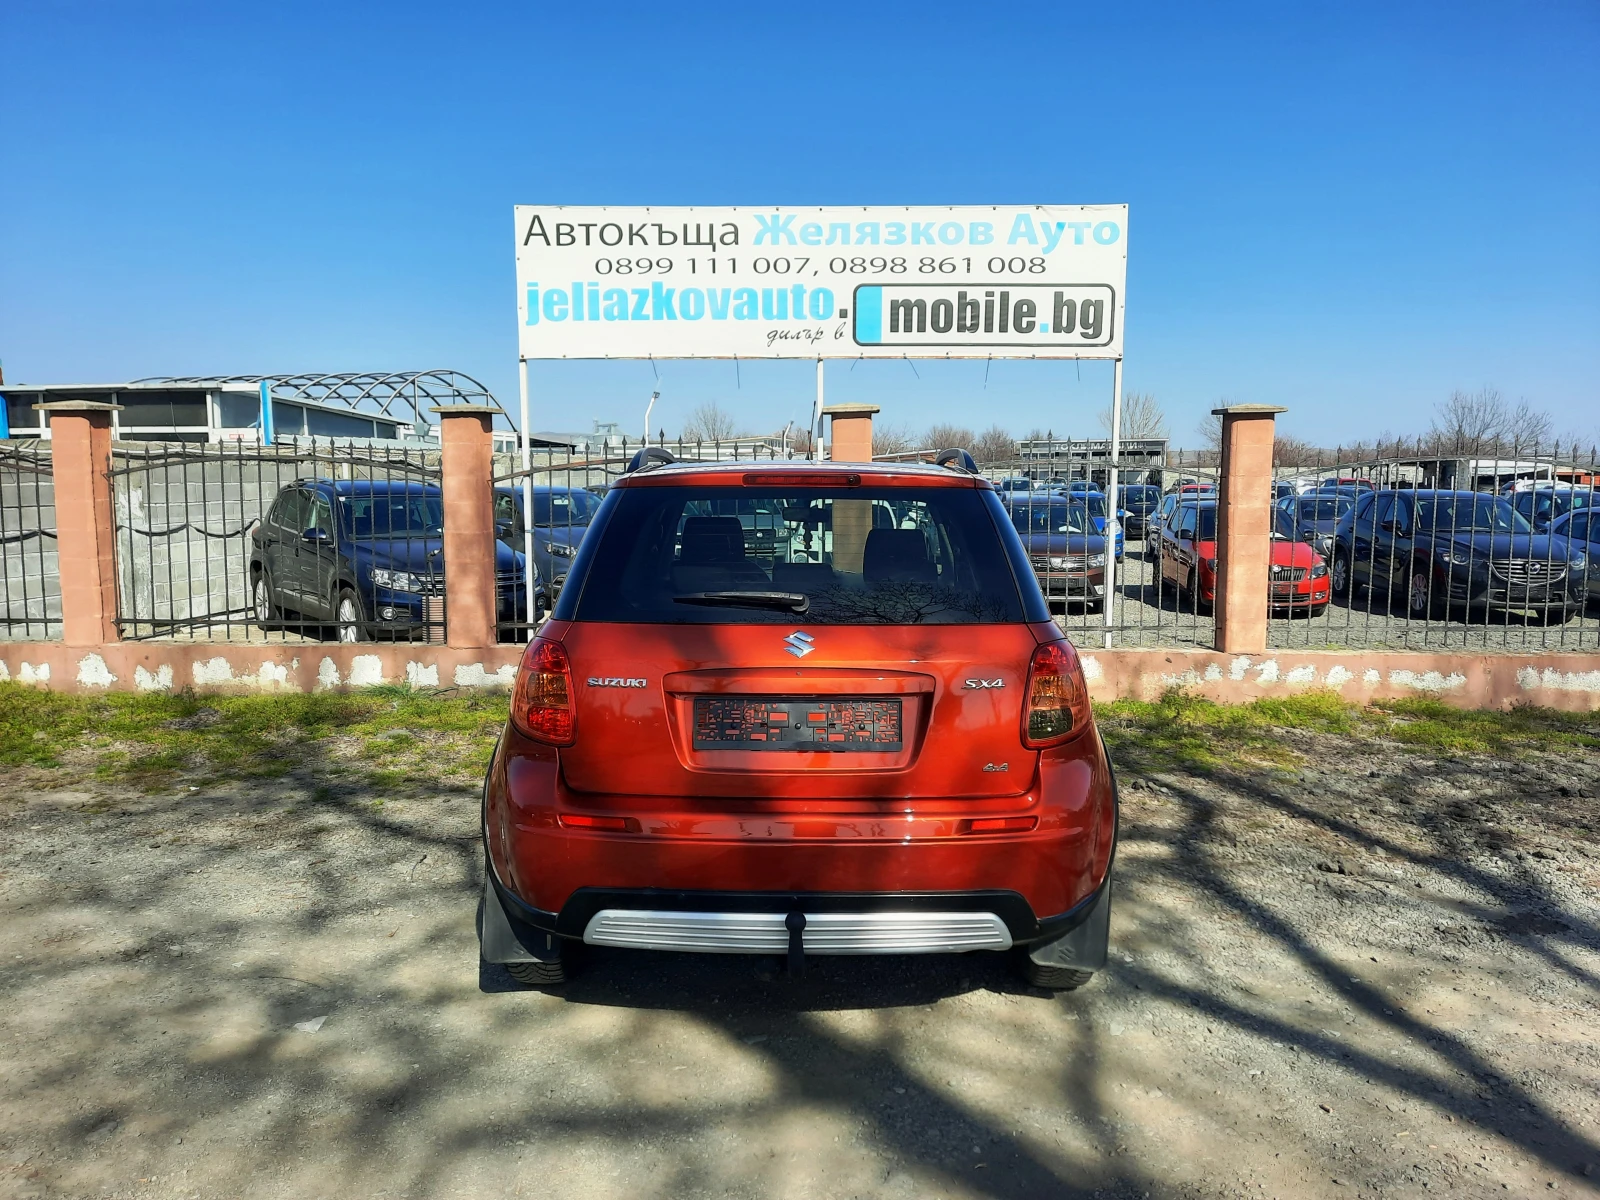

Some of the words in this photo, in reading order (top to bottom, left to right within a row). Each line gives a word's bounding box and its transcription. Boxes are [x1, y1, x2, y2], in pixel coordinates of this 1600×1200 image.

[523, 214, 740, 253] Автокъща
[752, 213, 995, 247] Желязков
[1006, 213, 1121, 255] Ауто
[594, 257, 674, 275] 0899
[686, 257, 738, 274] 111
[752, 257, 820, 277] 007,
[828, 256, 908, 274] 0898
[918, 256, 972, 274] 861
[987, 256, 1047, 274] 008
[889, 290, 1104, 340] mobile.bg
[587, 677, 648, 688] SUZUKI
[962, 678, 1006, 689] SX4
